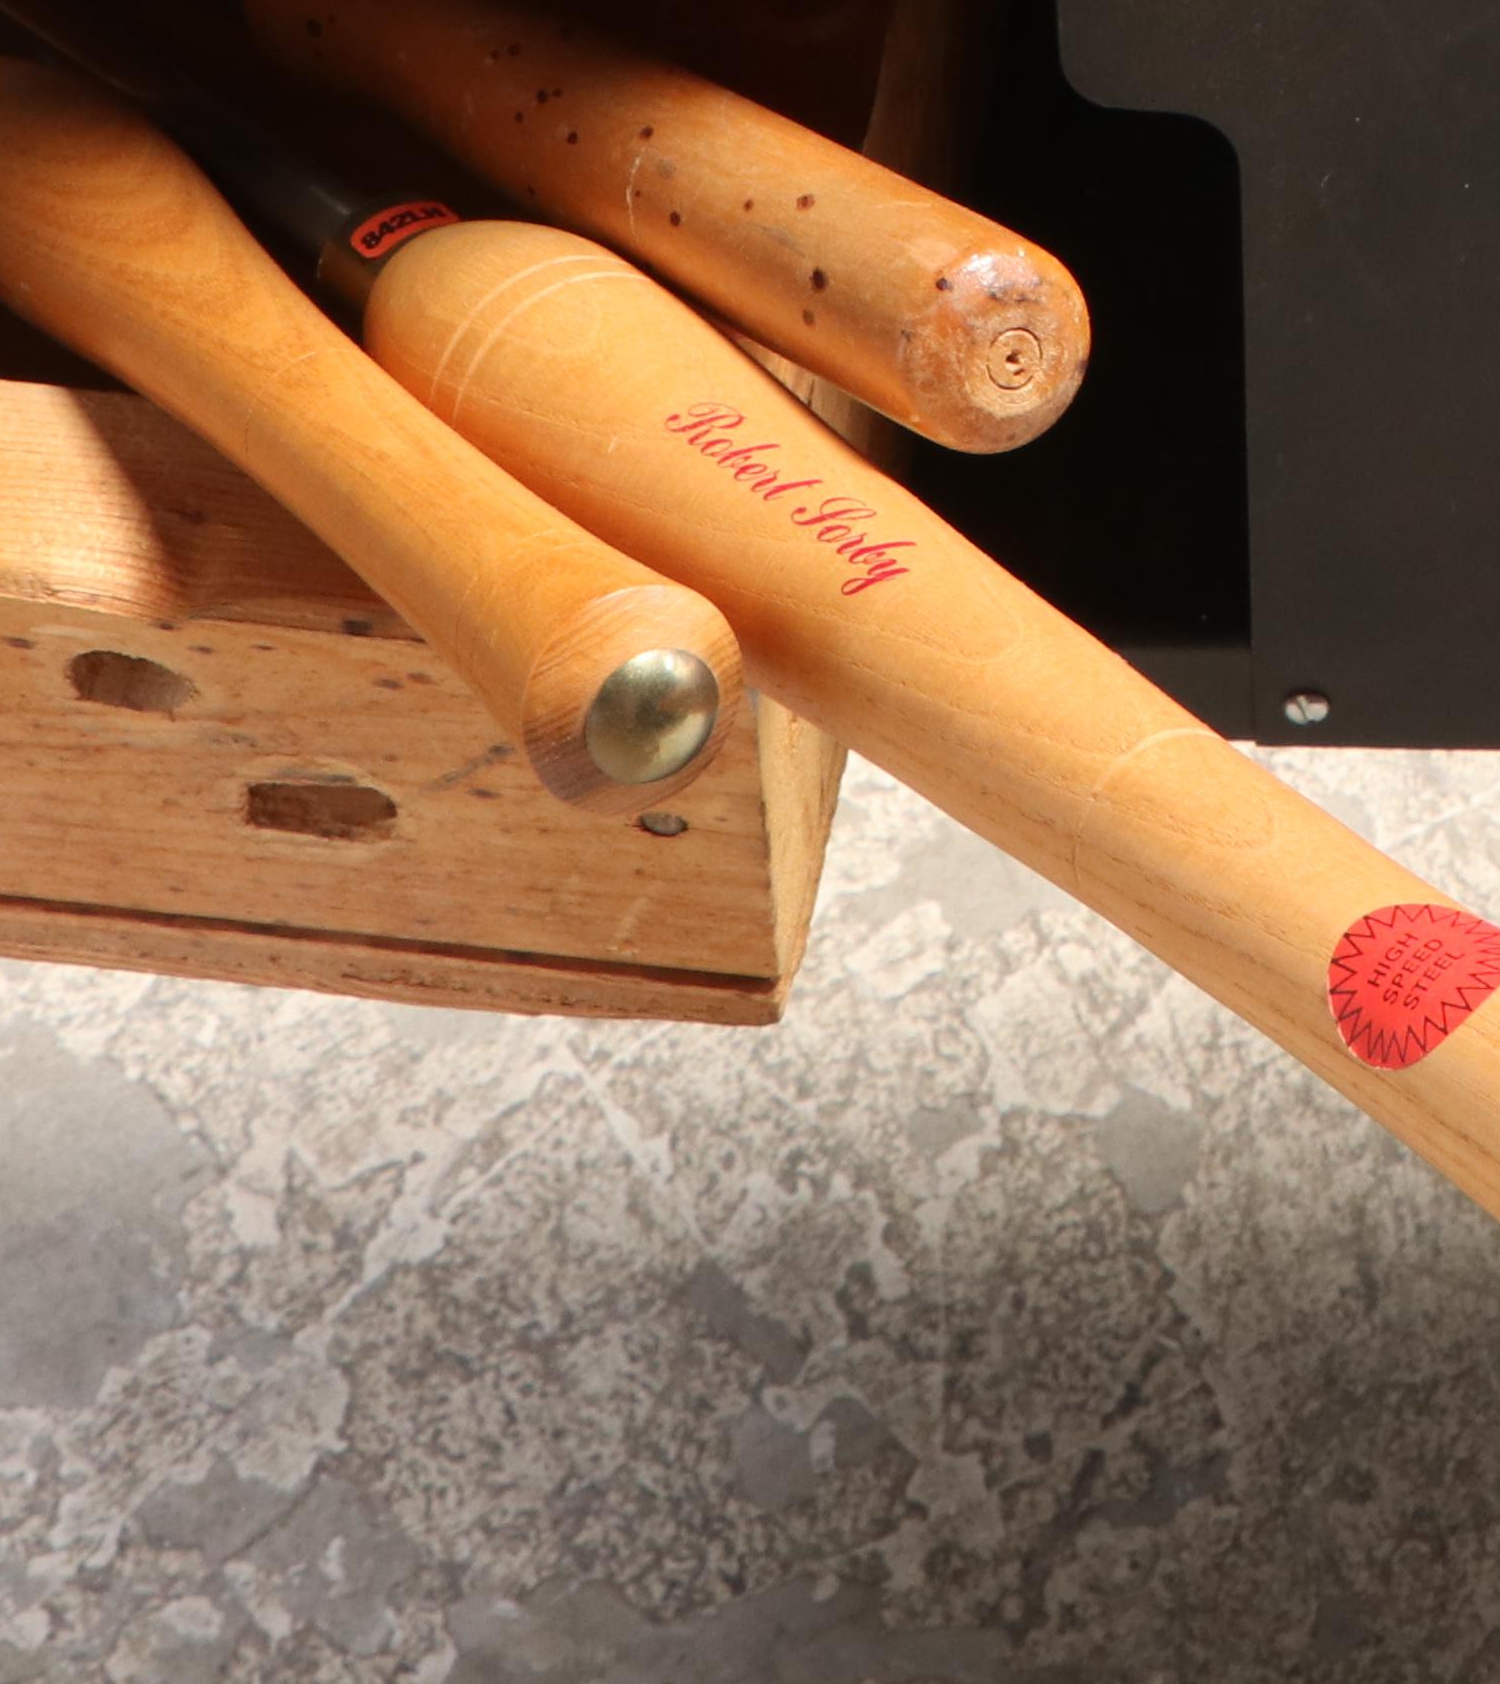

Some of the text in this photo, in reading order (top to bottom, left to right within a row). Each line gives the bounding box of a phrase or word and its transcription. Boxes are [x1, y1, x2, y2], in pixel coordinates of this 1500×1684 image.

[664, 401, 918, 597] Robert Sorby
[1366, 932, 1420, 989] HIGH
[1382, 937, 1443, 1006] SPEED
[1402, 952, 1466, 1011] STEEL
